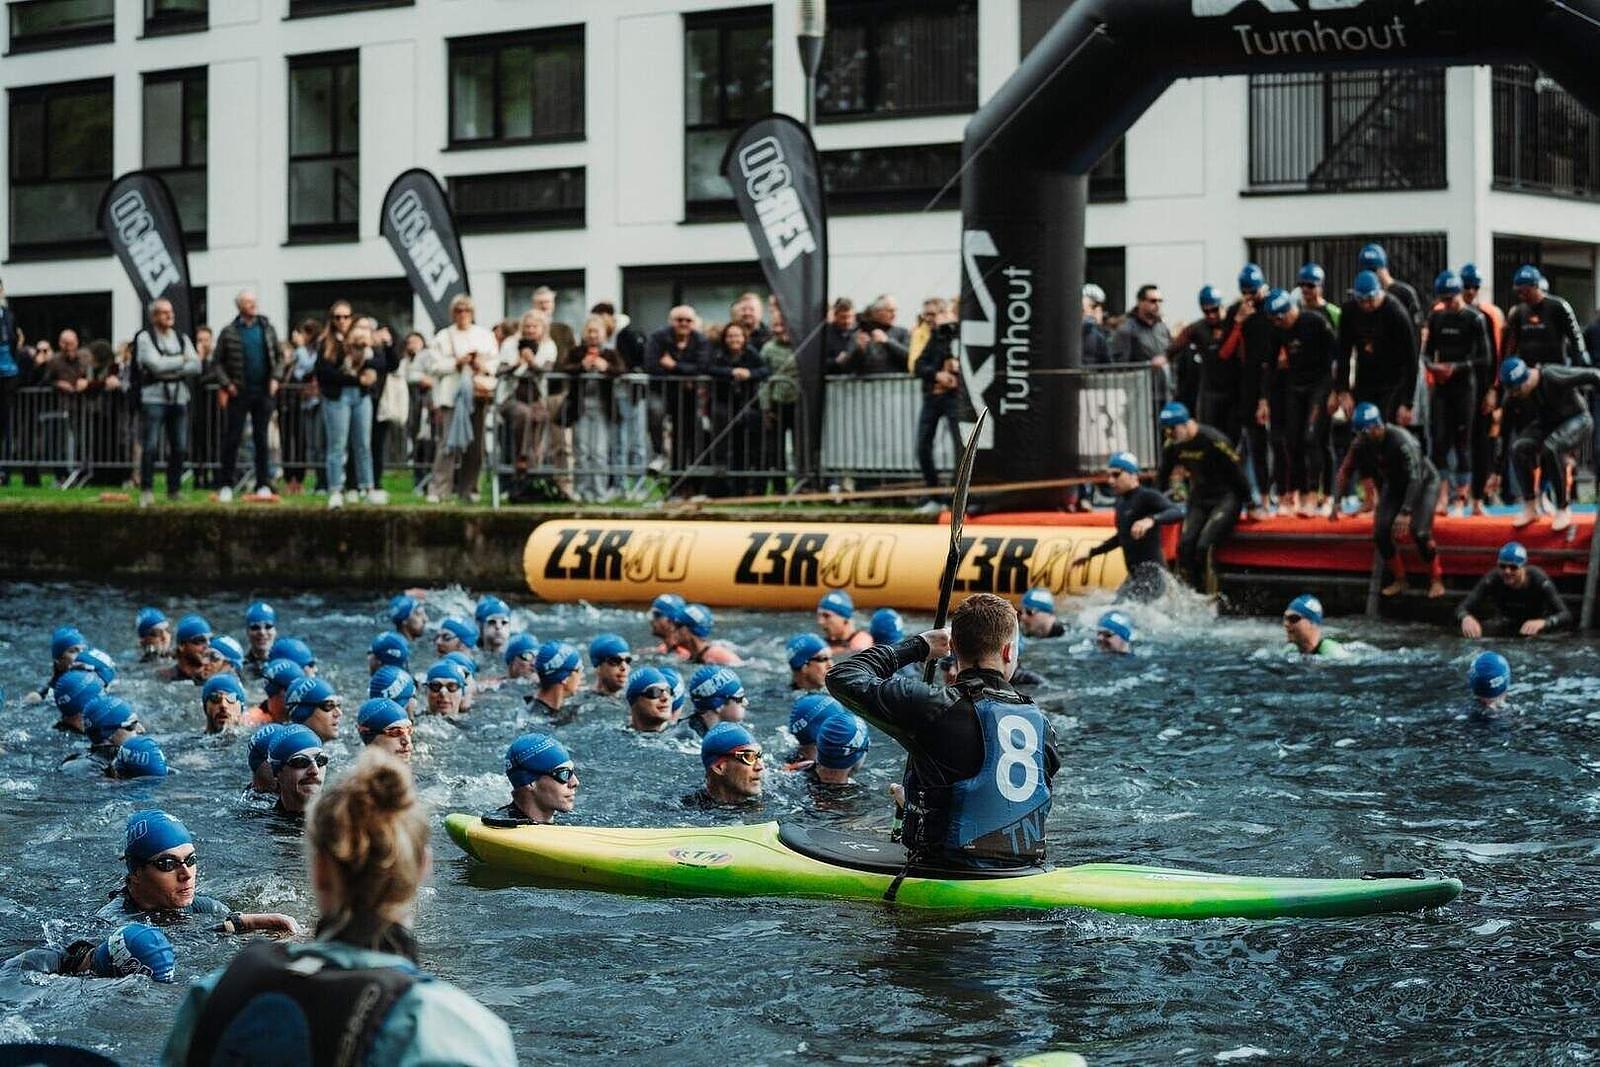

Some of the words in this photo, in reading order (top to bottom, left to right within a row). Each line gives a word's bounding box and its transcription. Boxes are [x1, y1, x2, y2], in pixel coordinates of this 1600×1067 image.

[1232, 15, 1407, 56] Turnhout
[1000, 265, 1033, 416] Turnhout
[995, 714, 1039, 803] 8
